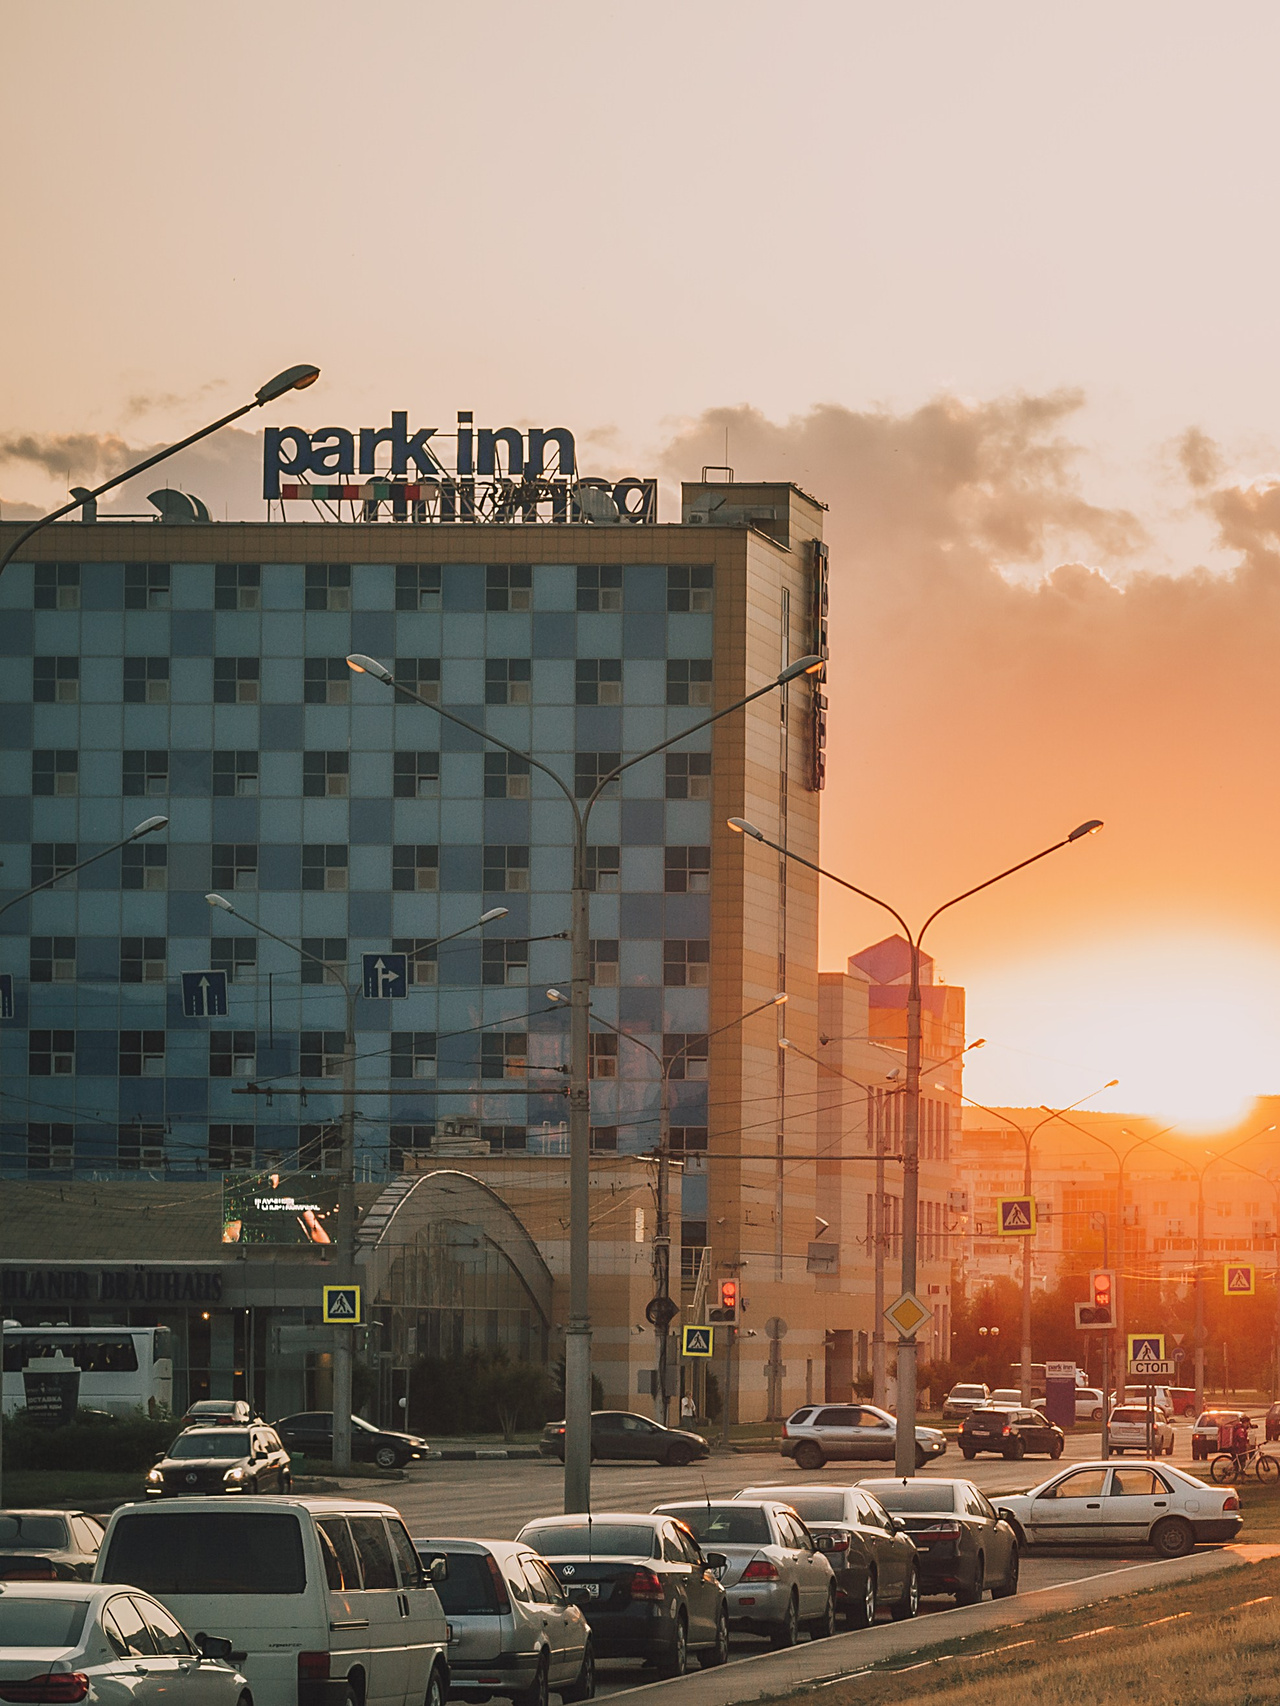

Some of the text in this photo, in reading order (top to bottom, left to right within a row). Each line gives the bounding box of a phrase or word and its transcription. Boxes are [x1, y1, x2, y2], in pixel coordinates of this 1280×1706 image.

[263, 410, 439, 499] park
[457, 411, 575, 476] inn
[100, 1264, 222, 1301] BRÄUHAUS
[1048, 1364, 1062, 1372] park
[1136, 1363, 1169, 1373] СТОП
